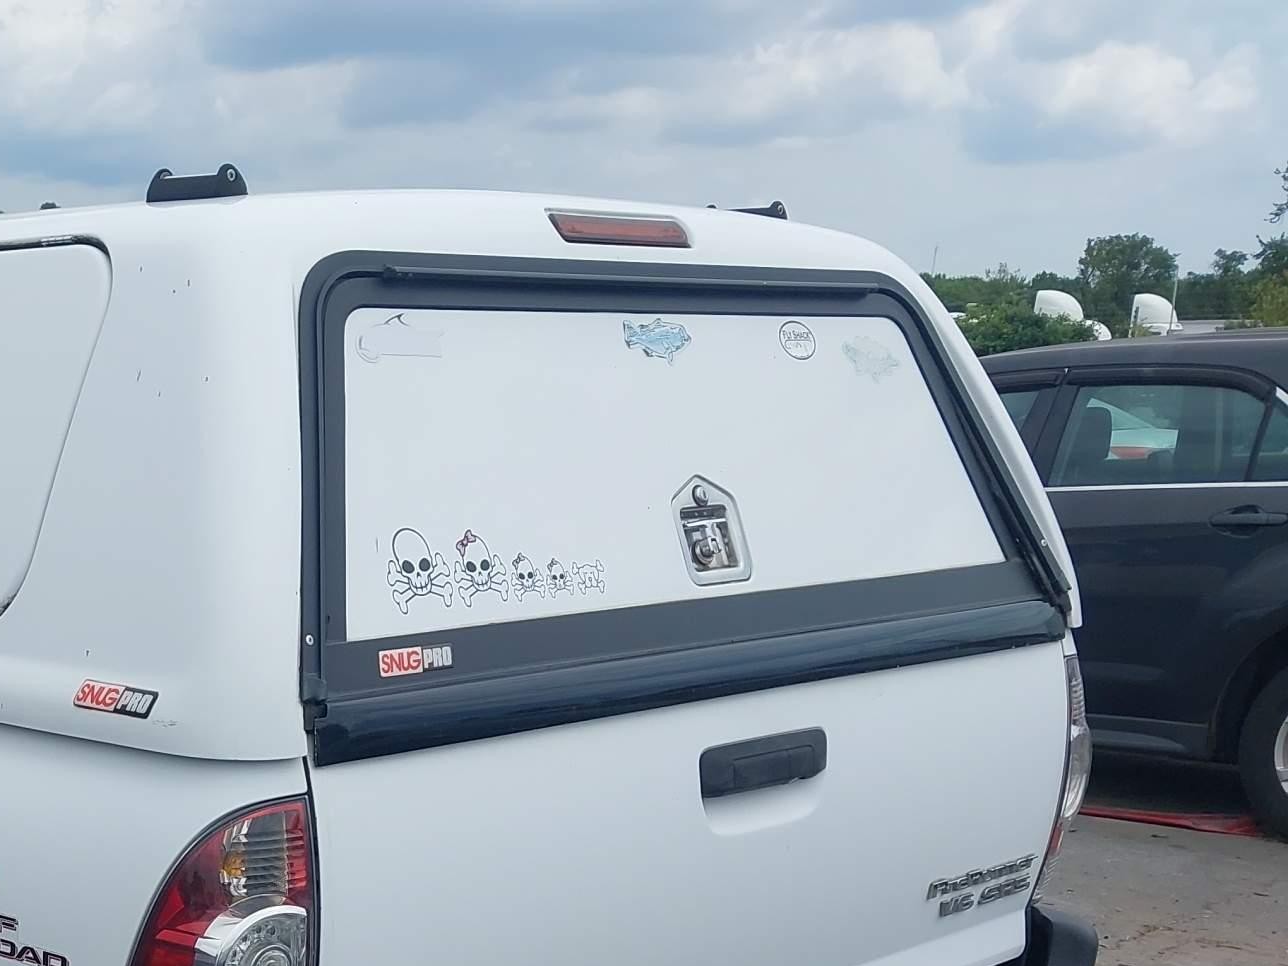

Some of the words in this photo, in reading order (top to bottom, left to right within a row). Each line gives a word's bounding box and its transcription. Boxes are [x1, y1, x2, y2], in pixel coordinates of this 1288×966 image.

[381, 650, 422, 673] SNUG
[423, 646, 453, 669] PRO
[76, 683, 120, 707] SNUG
[115, 690, 154, 714] PRO
